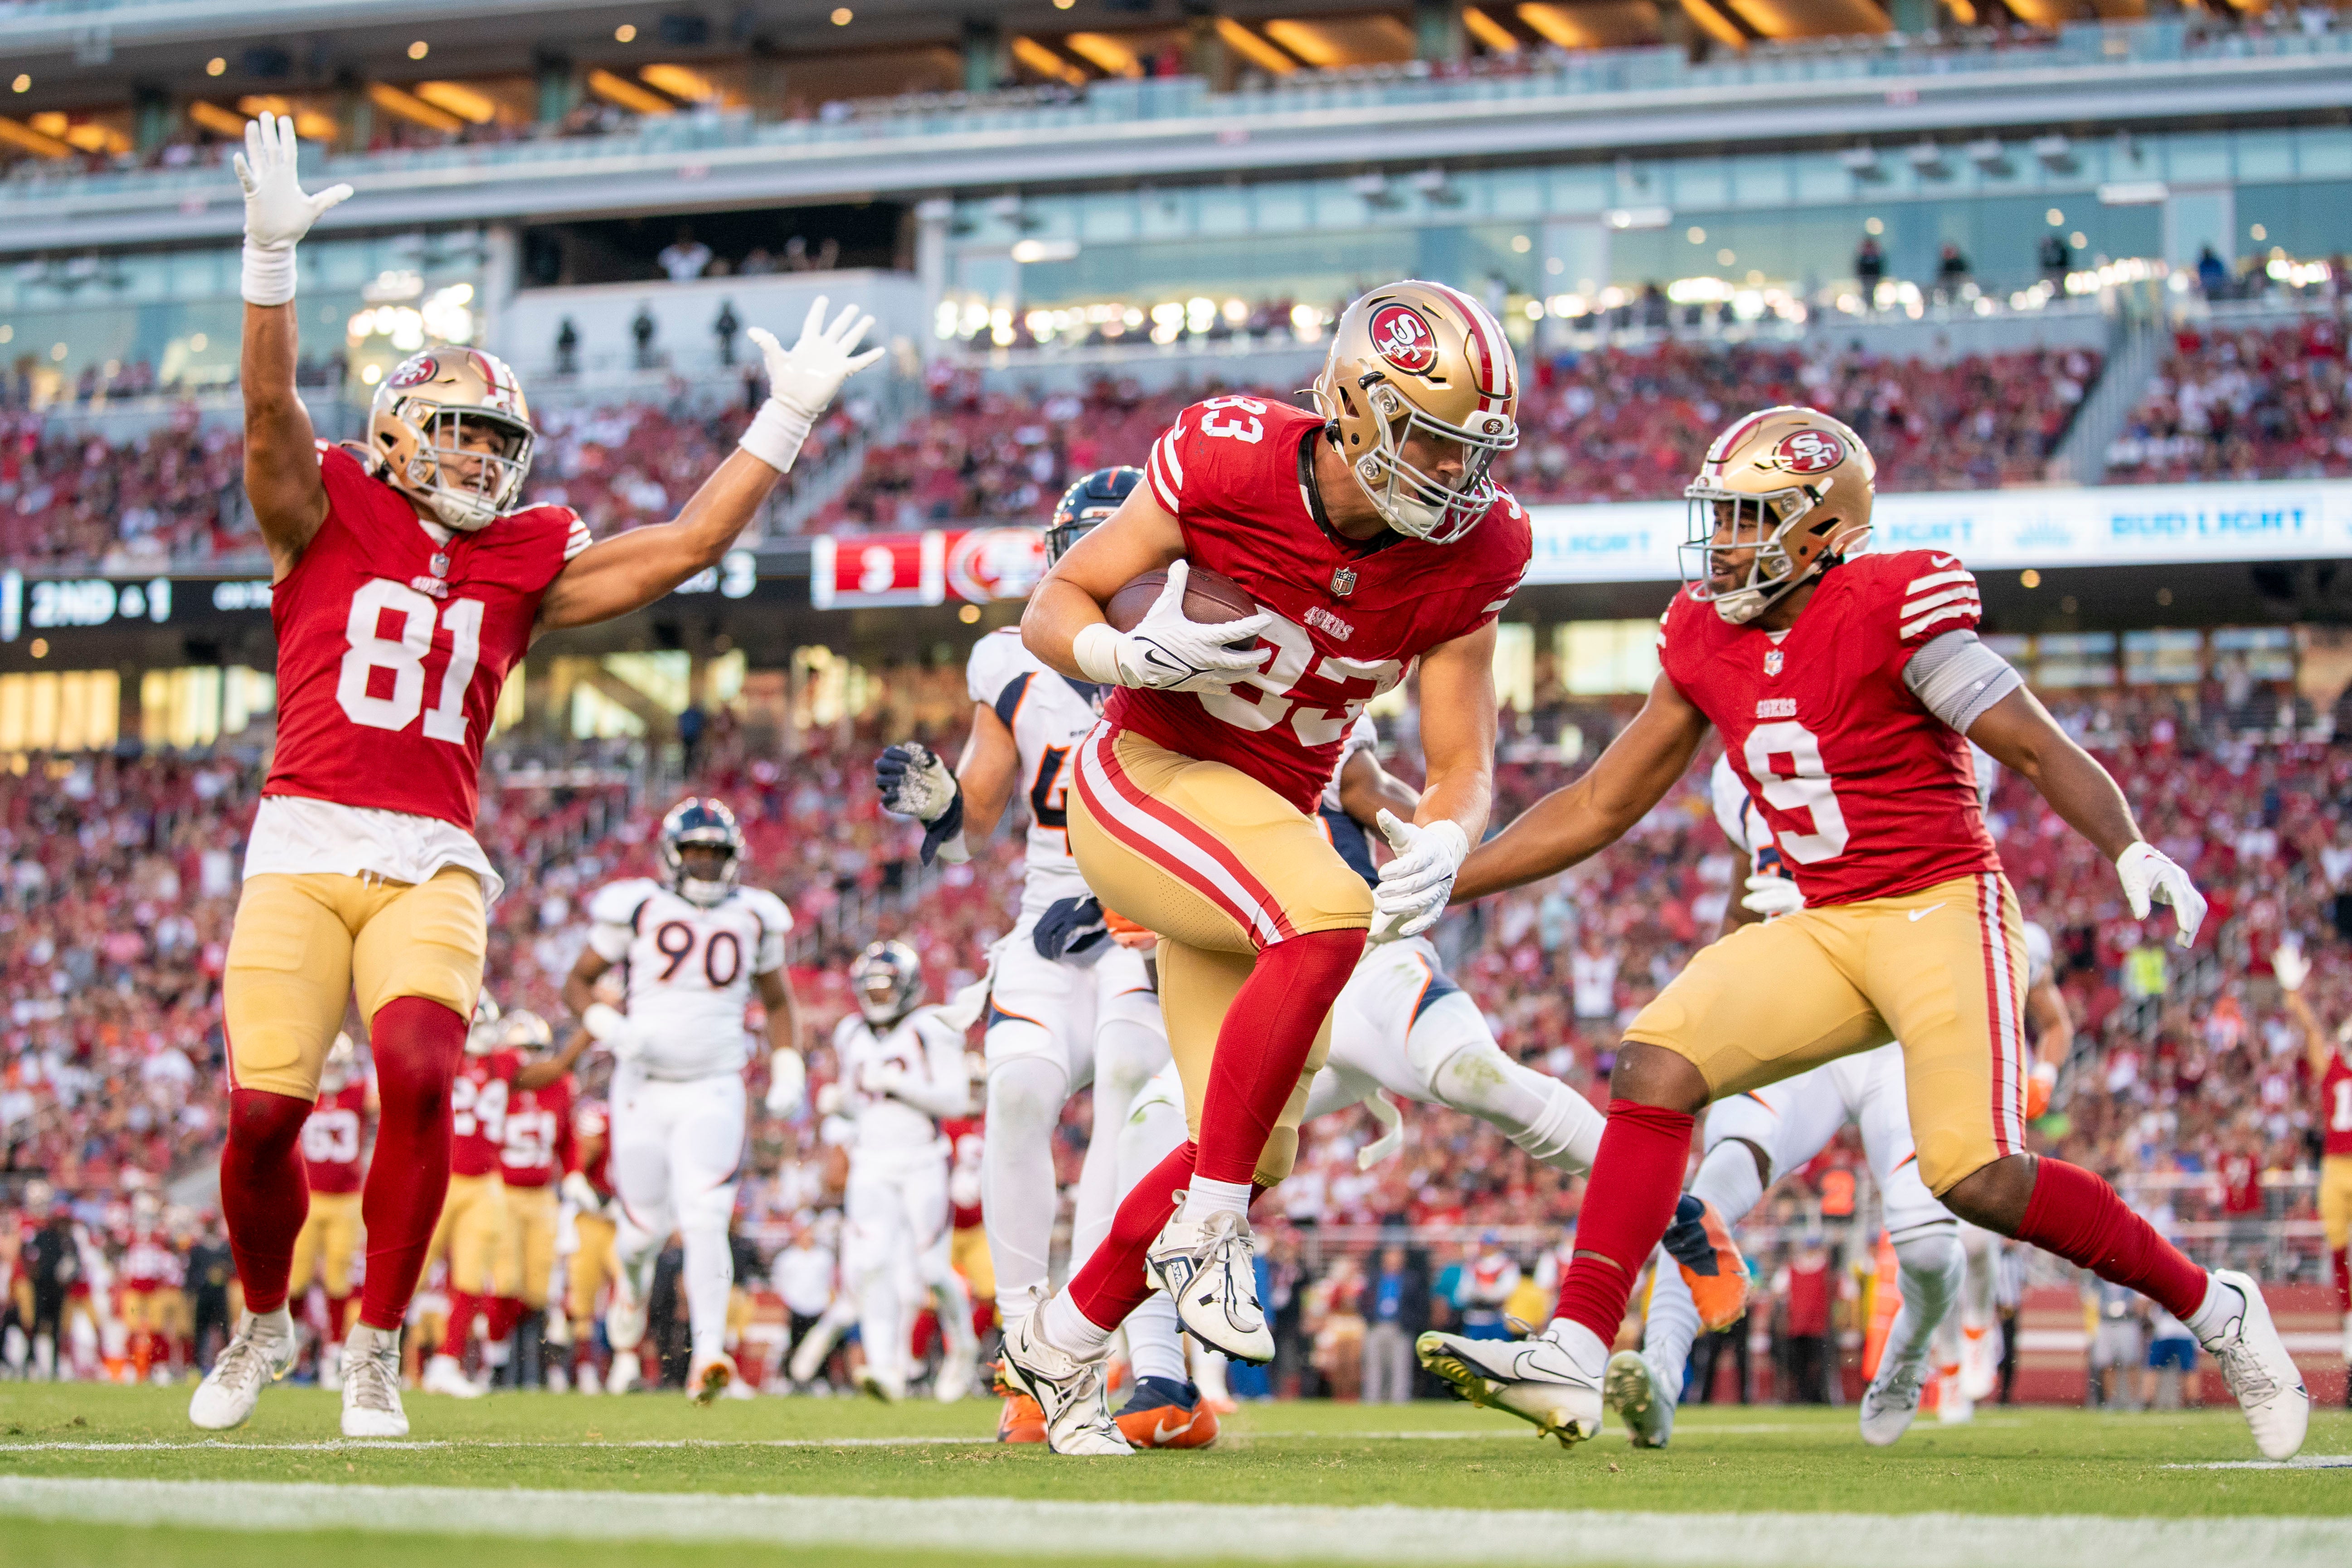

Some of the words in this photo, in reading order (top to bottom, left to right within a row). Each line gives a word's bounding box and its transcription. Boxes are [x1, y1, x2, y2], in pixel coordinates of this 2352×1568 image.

[336, 578, 485, 745] 81
[1304, 606, 1354, 641] 49ERS
[1744, 721, 1850, 865] 9
[656, 921, 742, 988] 90
